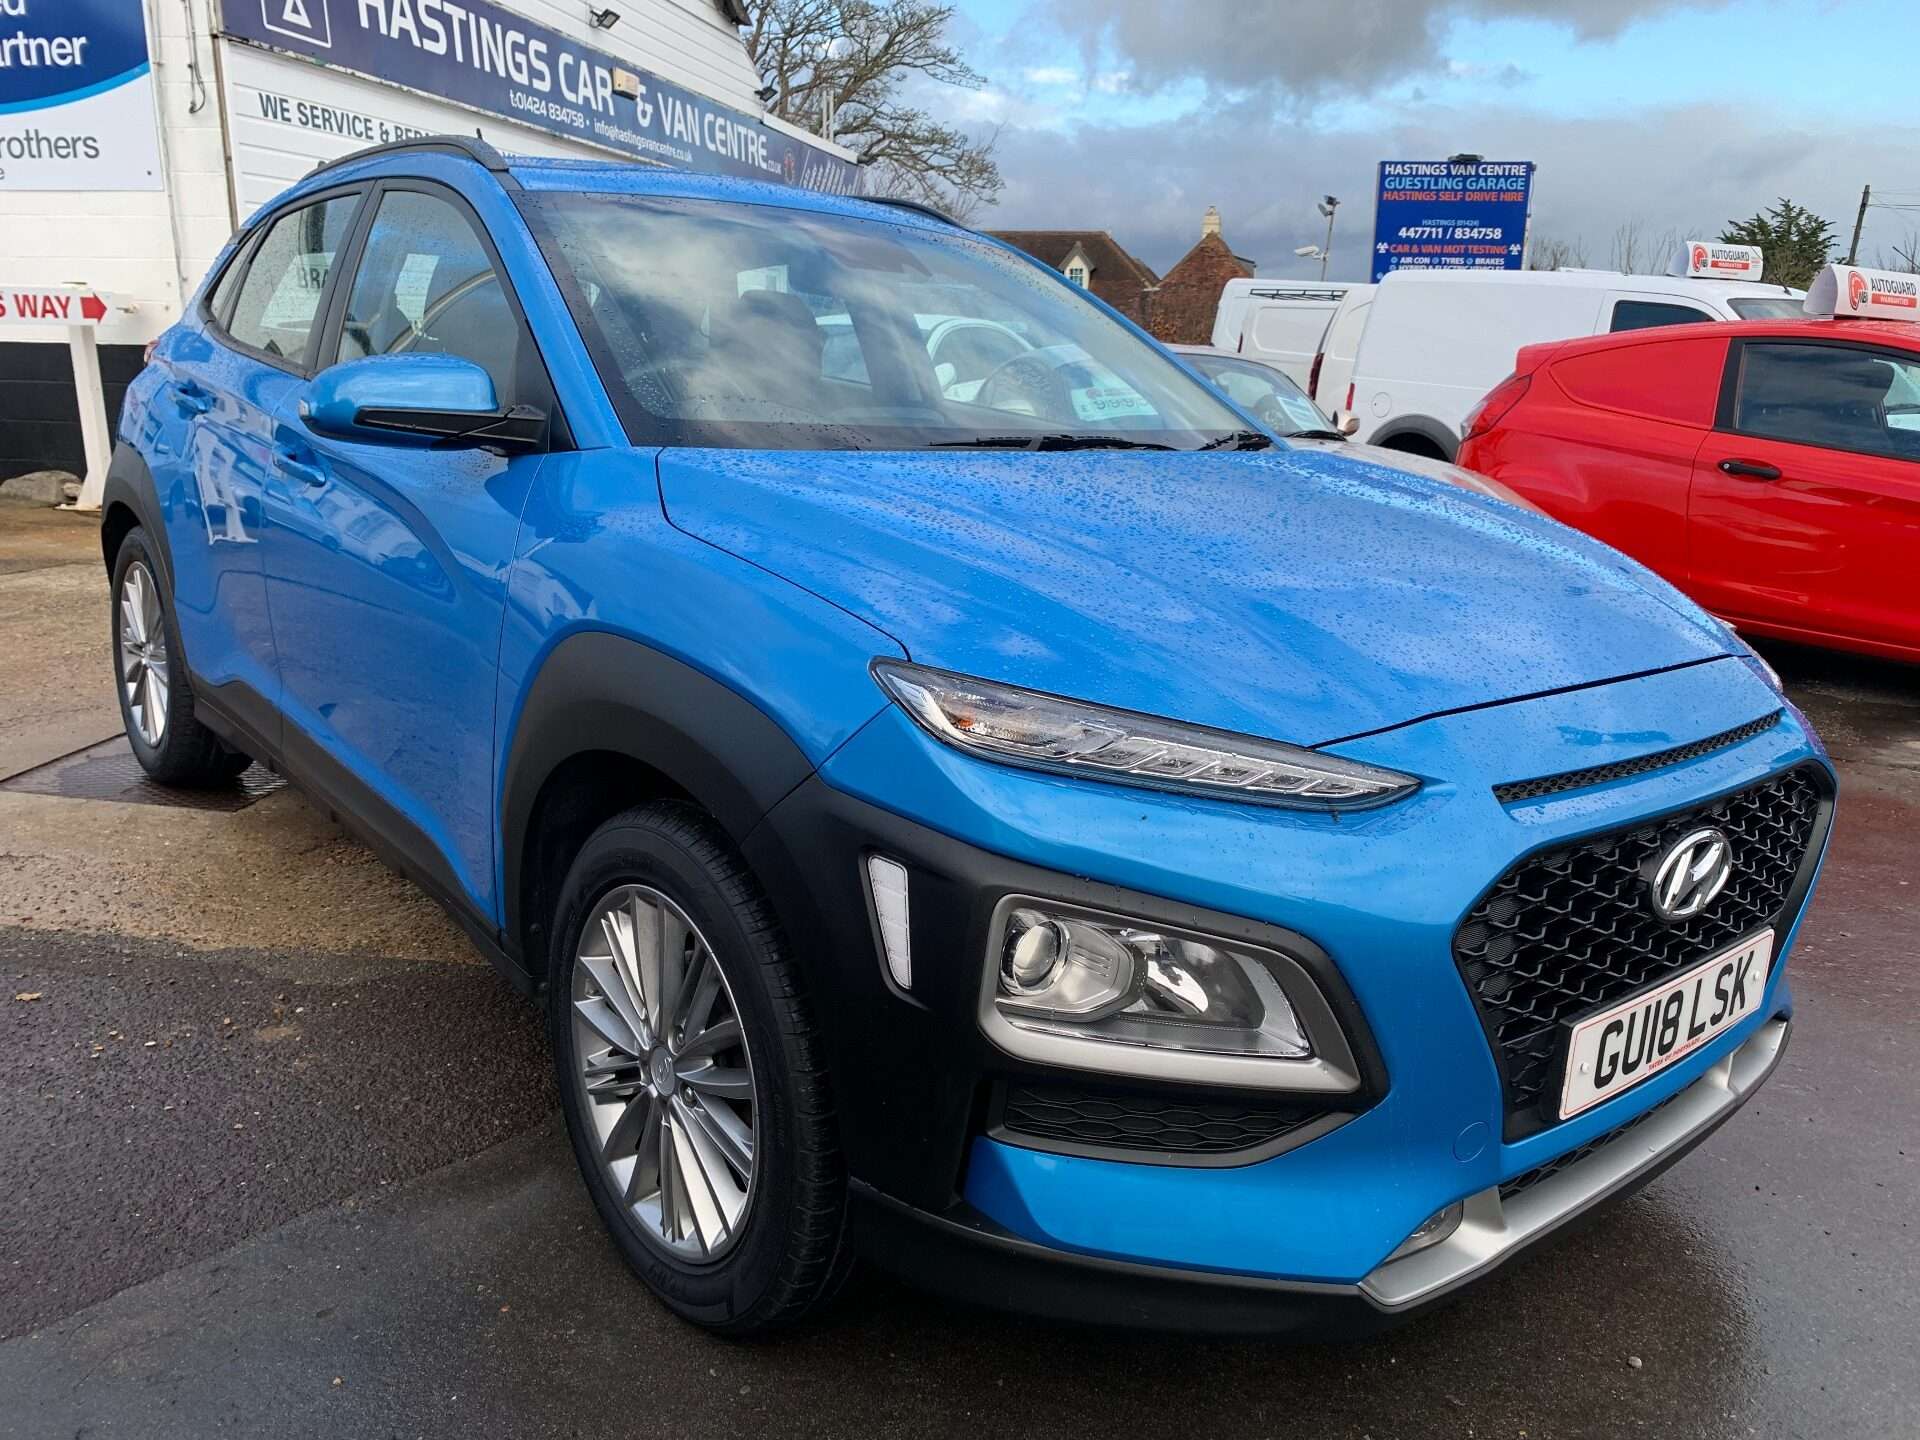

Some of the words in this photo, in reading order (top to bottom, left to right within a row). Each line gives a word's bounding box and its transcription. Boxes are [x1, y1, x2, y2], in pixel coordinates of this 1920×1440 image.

[358, 0, 551, 92] HASTINGS
[558, 53, 615, 116] CAR
[657, 92, 701, 146] VAN
[703, 113, 768, 170] CENTRE
[258, 92, 291, 123] WE
[296, 102, 374, 141] SERVICE
[549, 103, 585, 129] 834758
[1385, 163, 1447, 175] HASTINGS
[1450, 164, 1476, 175] VAN
[1478, 164, 1527, 176] CENTRE
[1384, 177, 1463, 190] GUESTLING
[1466, 177, 1526, 190] GARAGE
[1383, 191, 1437, 201] HASTINGS
[1438, 191, 1464, 201] SELF
[1465, 192, 1498, 201] DRIVE
[1500, 192, 1524, 202] HIRE
[1398, 227, 1442, 239] 447711
[1446, 227, 1453, 239] /
[1454, 227, 1502, 240] 834758
[1390, 244, 1409, 253] CAR
[1421, 244, 1441, 253] VAN
[1443, 244, 1465, 254] MOT
[1468, 245, 1508, 254] TESTING
[1711, 249, 1750, 262] AUTOGUARD
[1414, 257, 1430, 265] CON
[1441, 257, 1464, 265] TYRES
[1871, 278, 1917, 296] AUTOGUARD
[13, 294, 70, 318] WAY
[1594, 990, 1684, 1089] GU18
[1687, 951, 1754, 1041] LSK
